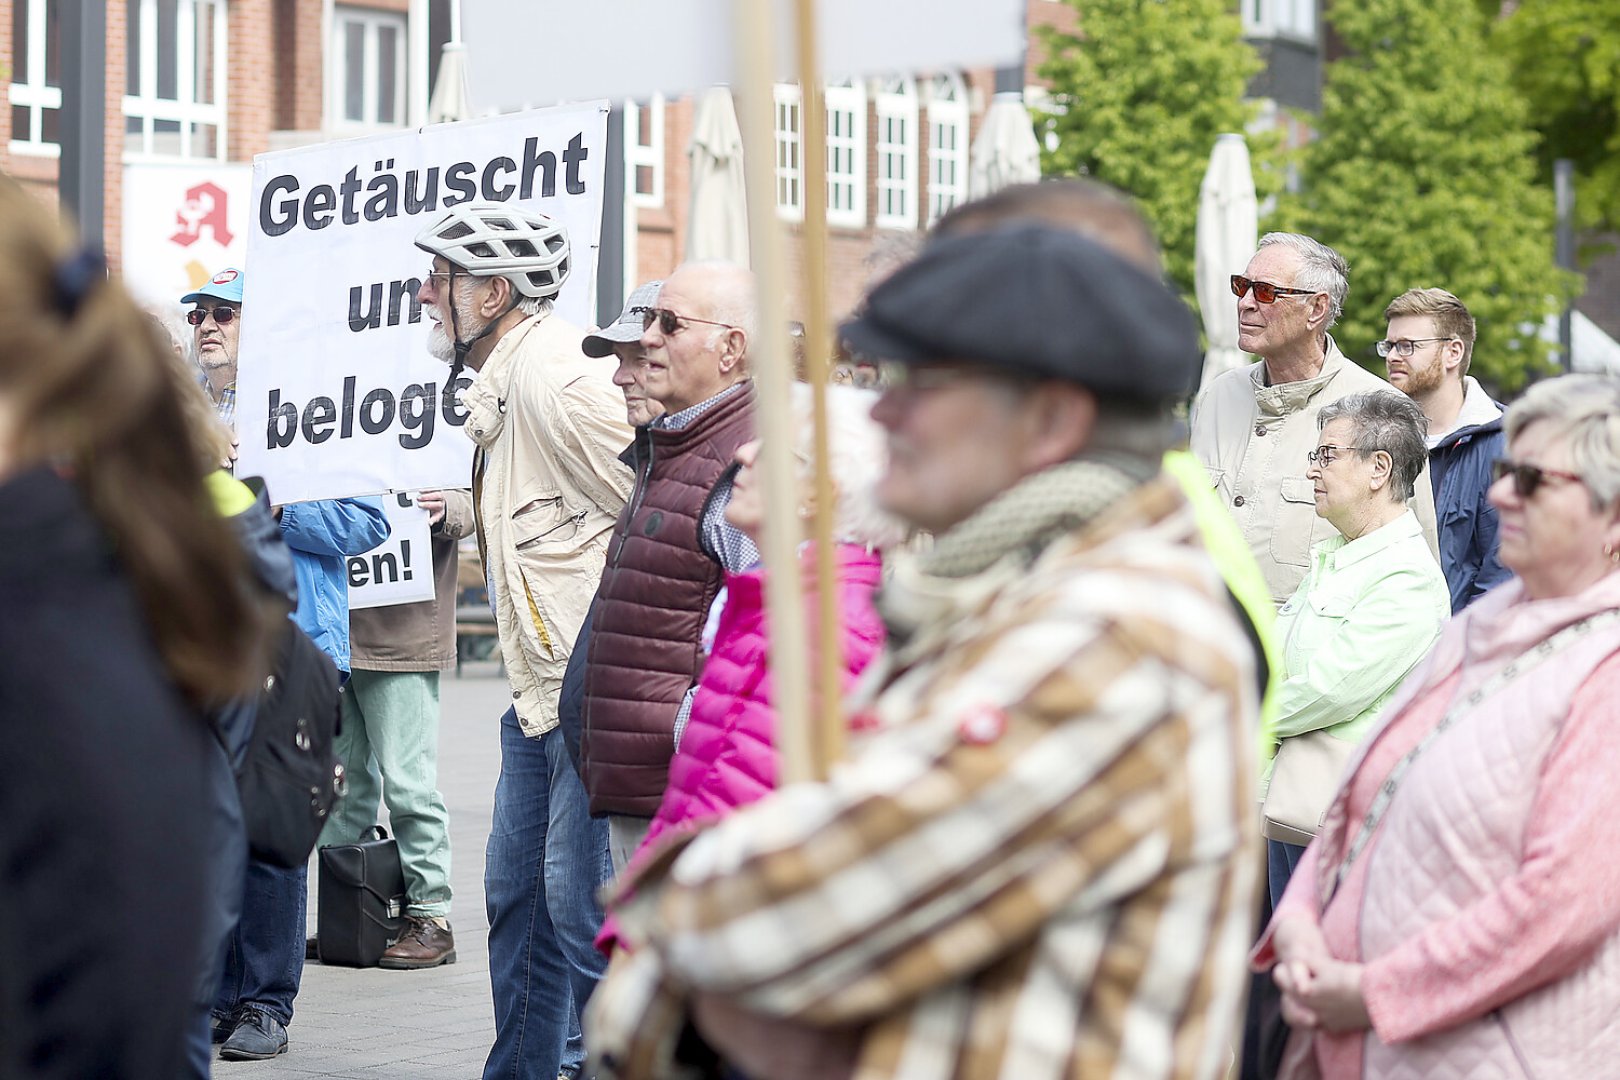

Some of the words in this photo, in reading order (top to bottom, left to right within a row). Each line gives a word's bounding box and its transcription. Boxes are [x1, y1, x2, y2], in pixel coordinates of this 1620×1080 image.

[259, 131, 589, 237] Getäuscht
[348, 277, 422, 333] un
[266, 376, 474, 450] beloge
[346, 539, 413, 588] en!
